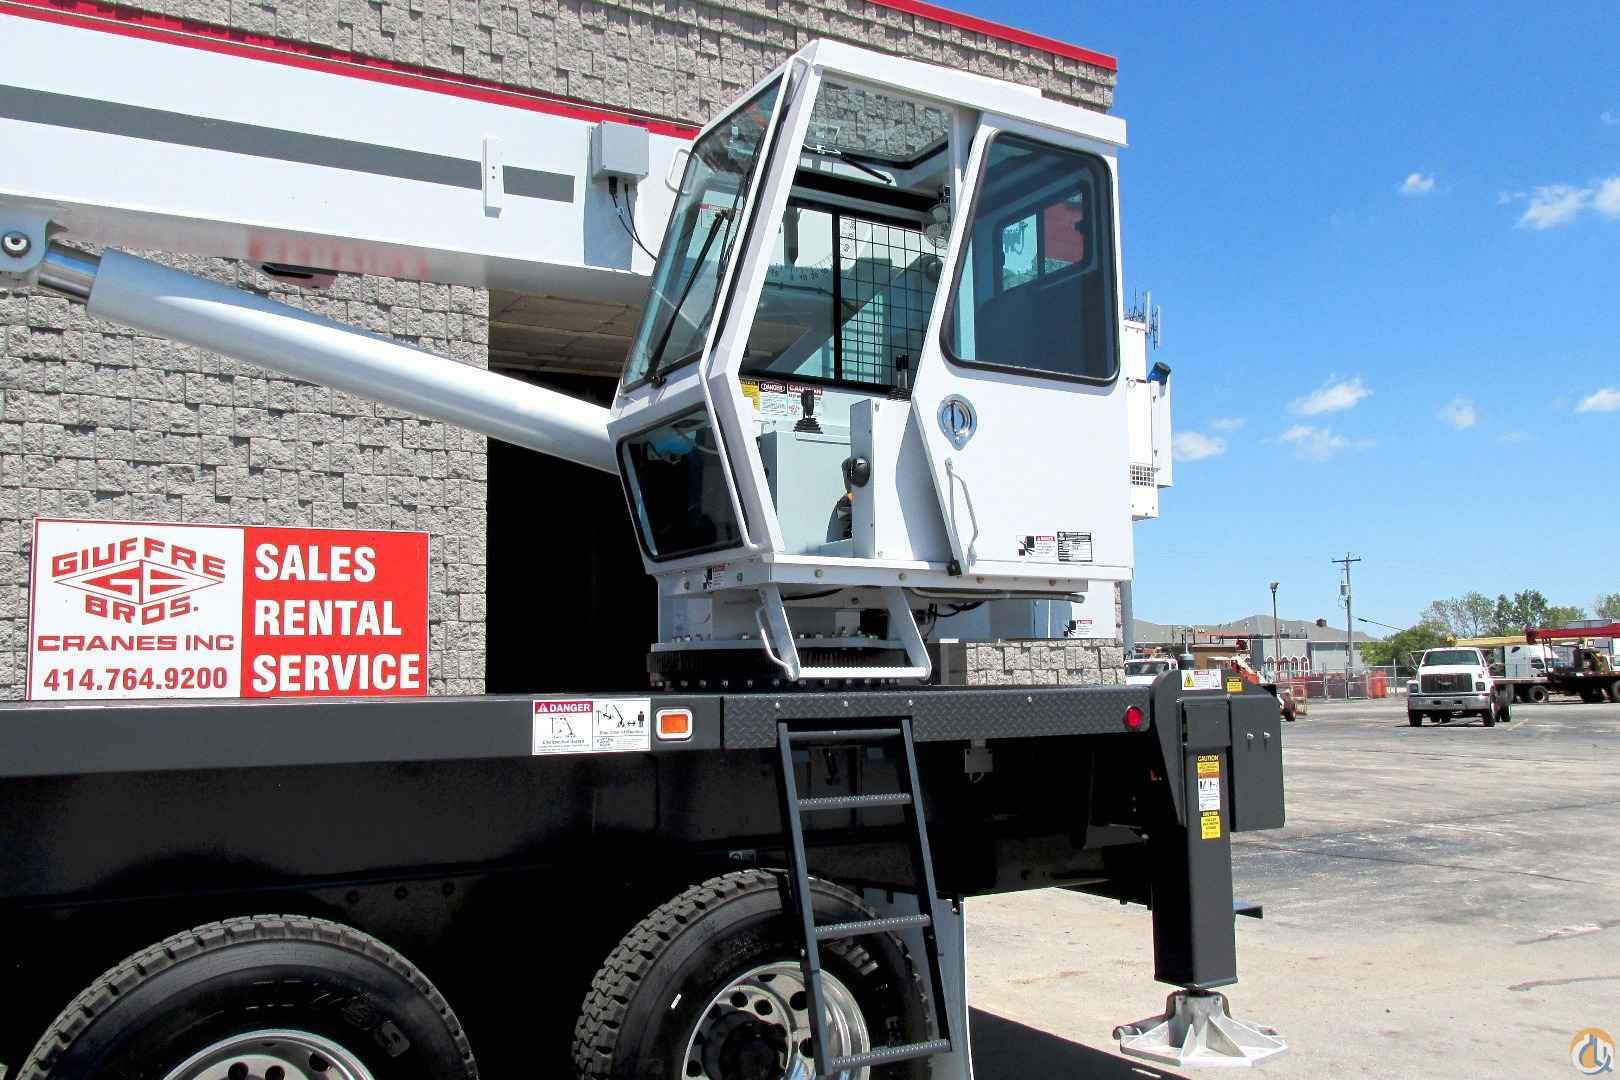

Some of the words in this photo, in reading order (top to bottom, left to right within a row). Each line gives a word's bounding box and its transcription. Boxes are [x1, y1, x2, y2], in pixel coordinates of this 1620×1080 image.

[52, 537, 225, 578] GIUFFRE
[255, 543, 376, 582] SALES
[85, 595, 199, 625] BROS.
[254, 600, 402, 636] RENTAL
[37, 635, 177, 651] CRANES
[186, 635, 234, 651] INC
[43, 667, 228, 691] 414.764.9200
[252, 653, 420, 692] SERVICE
[549, 703, 591, 713] DANGER
